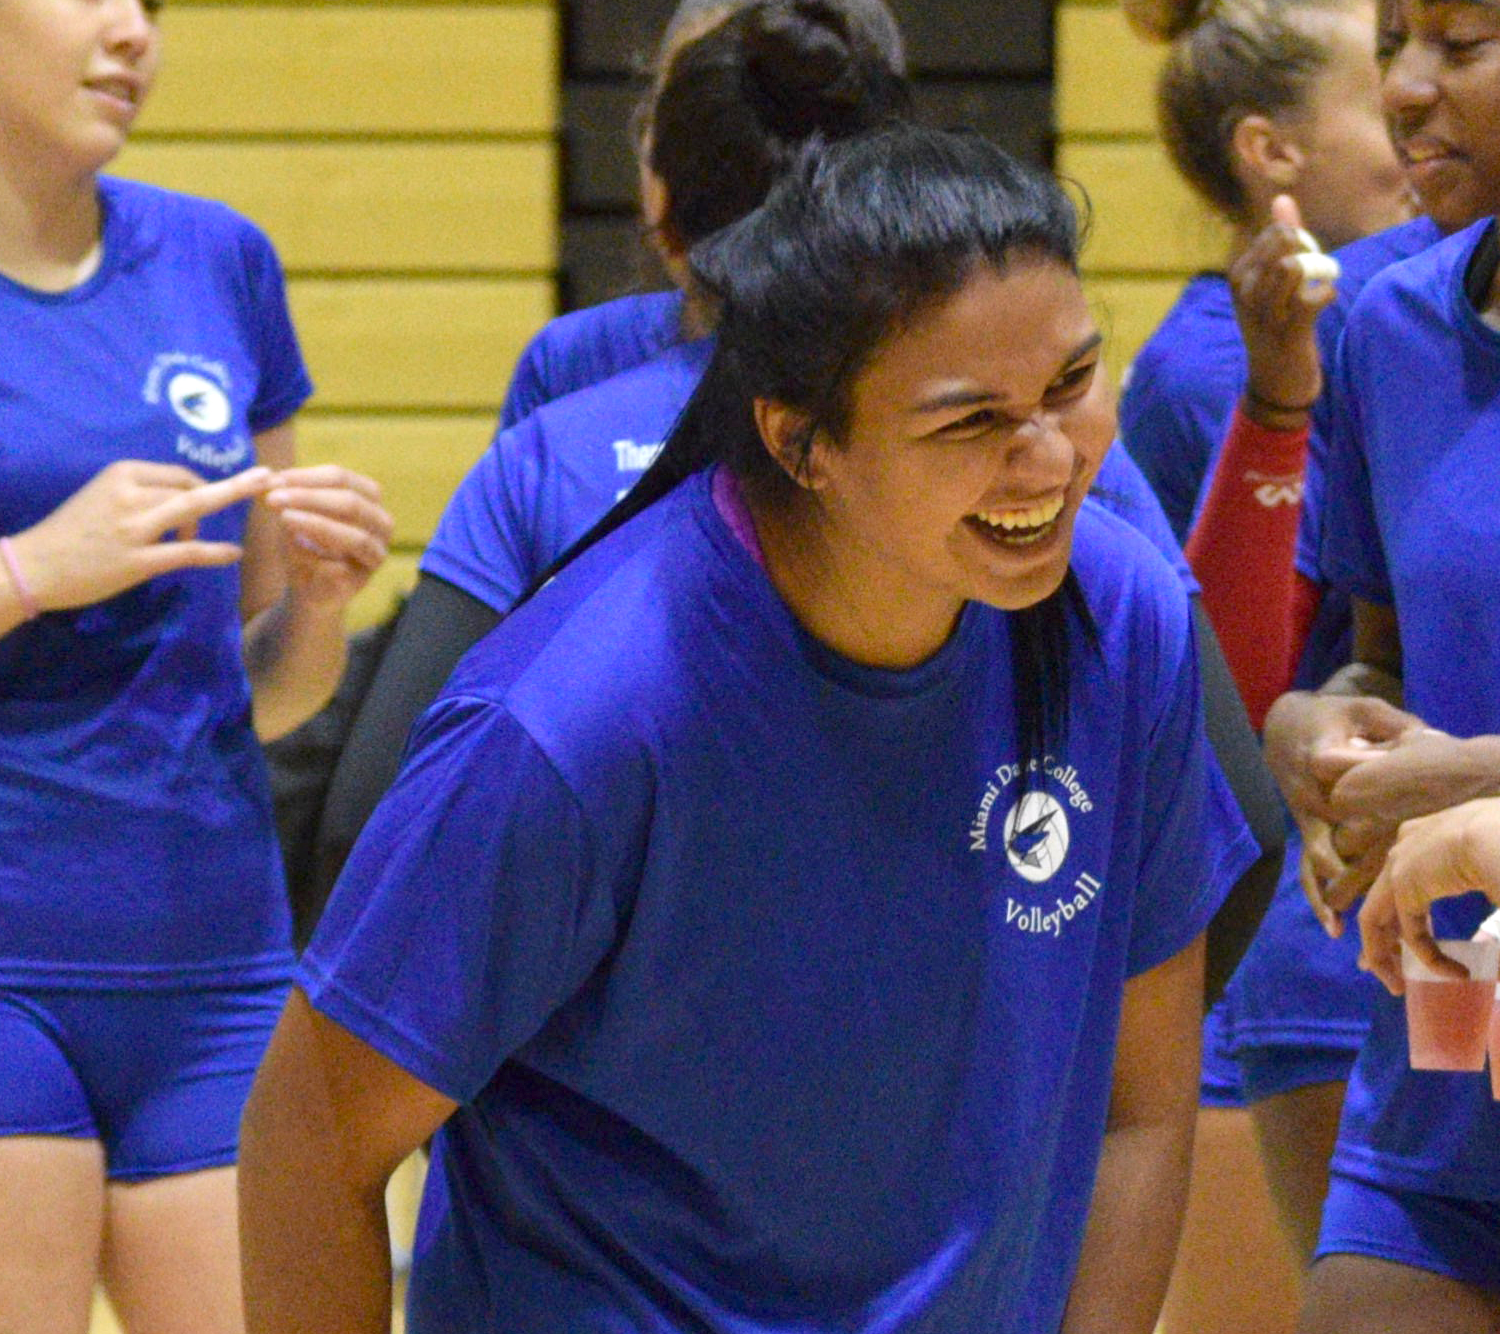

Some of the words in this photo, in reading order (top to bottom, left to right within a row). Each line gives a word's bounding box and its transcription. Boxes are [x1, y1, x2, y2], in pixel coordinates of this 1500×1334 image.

[970, 781, 1000, 852] Miami
[995, 755, 1038, 788] Dae
[1043, 754, 1094, 814] College
[1004, 871, 1102, 937] Volleyball
